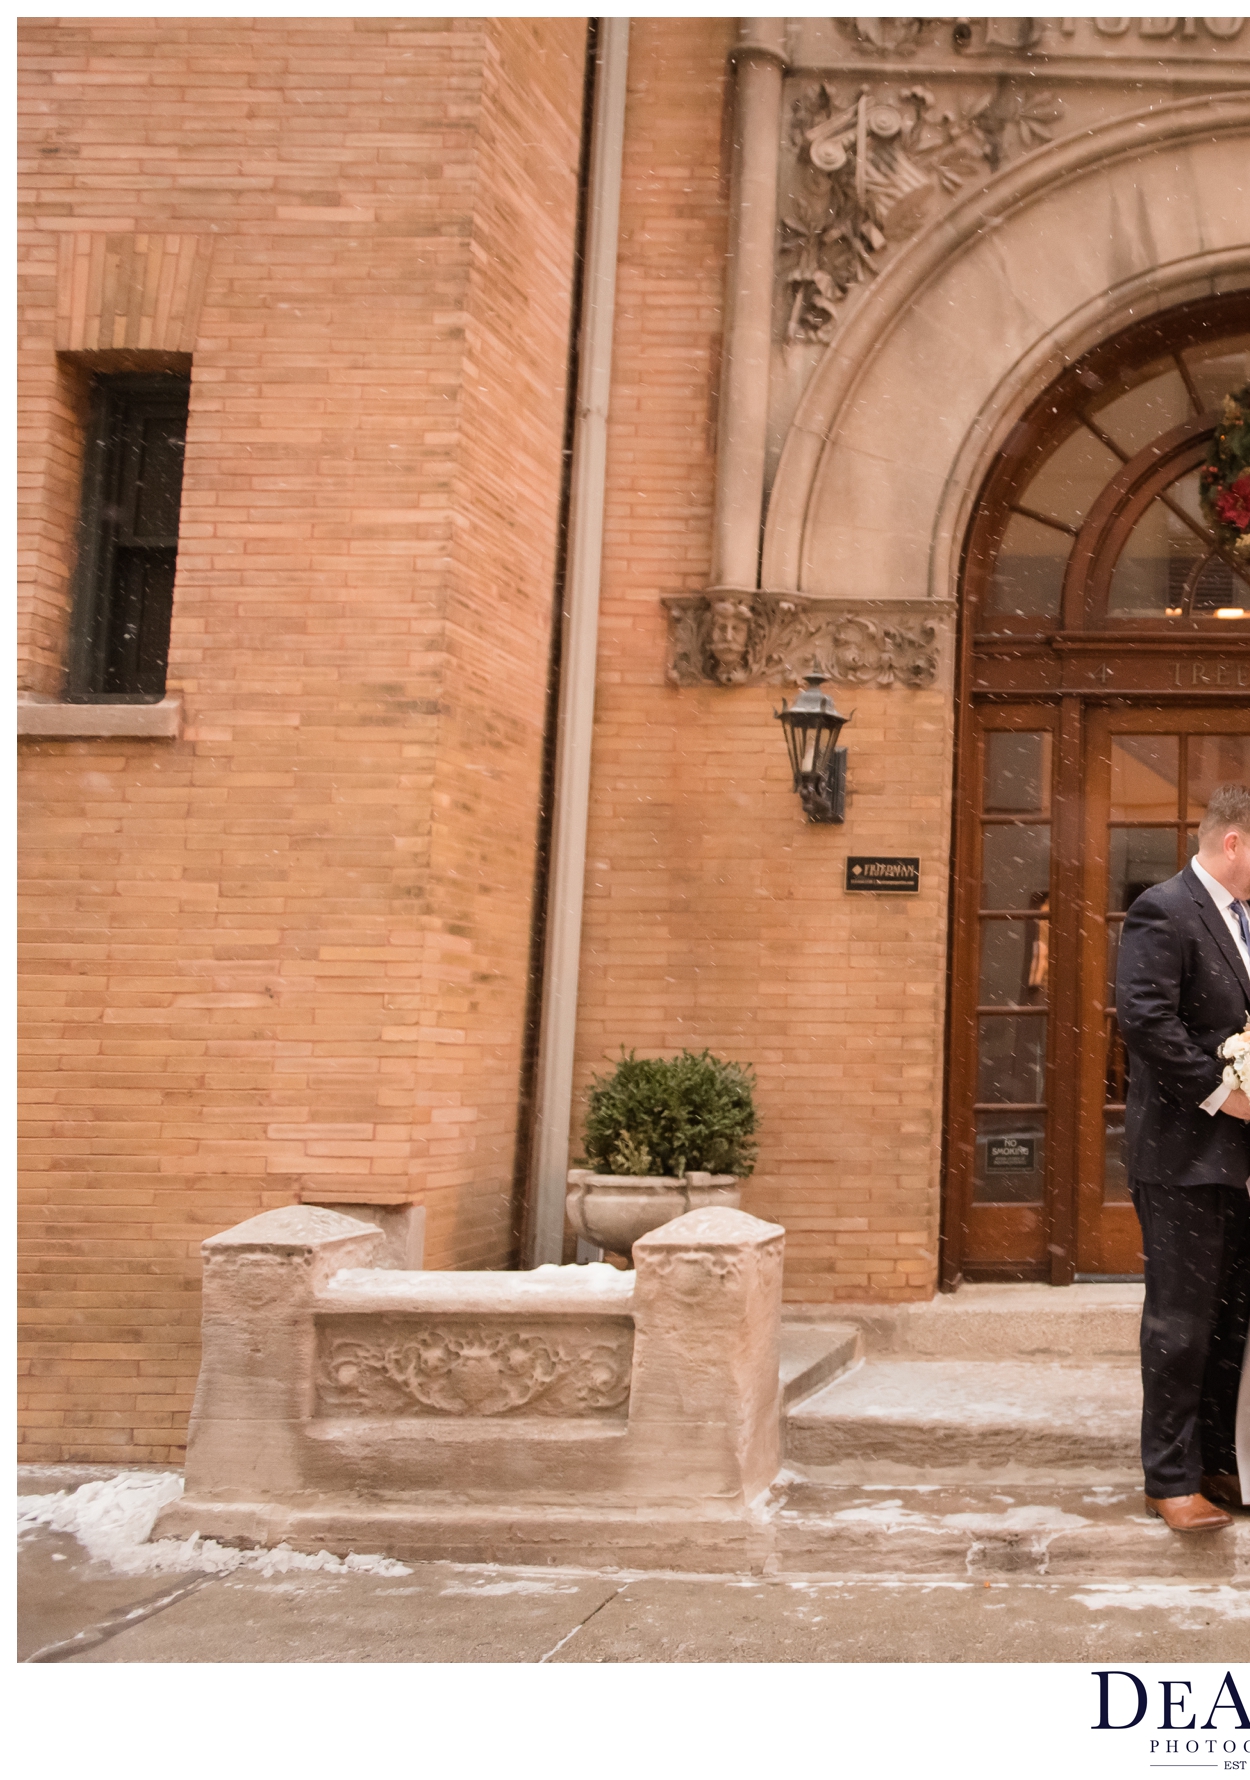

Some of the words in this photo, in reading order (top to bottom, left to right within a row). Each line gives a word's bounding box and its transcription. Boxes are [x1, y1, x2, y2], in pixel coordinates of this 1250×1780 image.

[1093, 662, 1111, 685] 4
[1168, 662, 1250, 686] TREE
[1004, 1139, 1018, 1147] NO
[992, 1147, 1029, 1156] SMOKING
